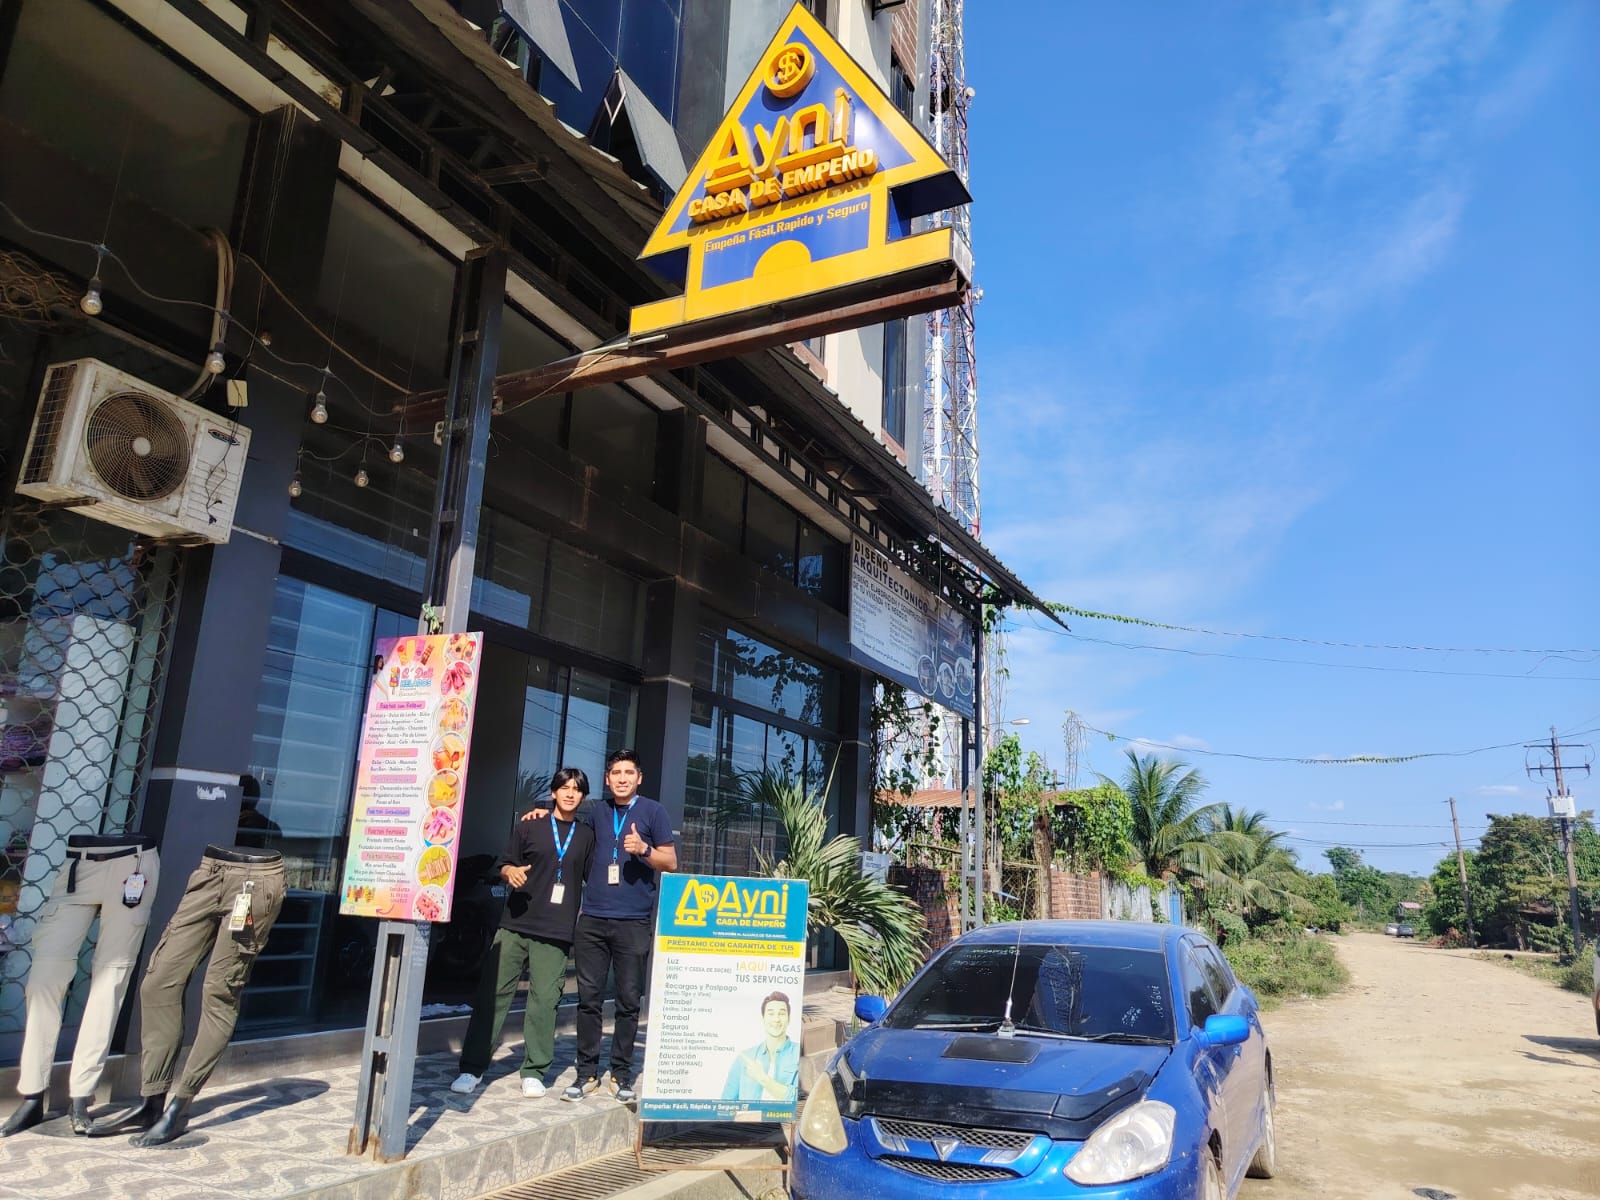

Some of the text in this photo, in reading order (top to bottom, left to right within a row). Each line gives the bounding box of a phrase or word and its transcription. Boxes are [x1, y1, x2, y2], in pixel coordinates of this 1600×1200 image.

[705, 87, 852, 182] Ayni
[688, 188, 747, 219] CASA
[750, 177, 780, 203] DE
[705, 235, 746, 253] Empeña
[817, 213, 825, 226] y
[826, 200, 868, 220] Seguro
[854, 553, 929, 613] ARQUITECTONICO
[717, 881, 789, 917] Ayni
[716, 918, 739, 927] CASA
[740, 919, 752, 928] DE
[767, 943, 777, 951] DE
[667, 957, 679, 965] Luz
[770, 963, 801, 973] PAGAS
[735, 974, 799, 985] TUS SERVICIOS
[665, 982, 698, 991] Recargas
[661, 1022, 689, 1031] Seguros
[656, 1077, 681, 1085] Natura
[656, 1086, 693, 1095] Tuperware
